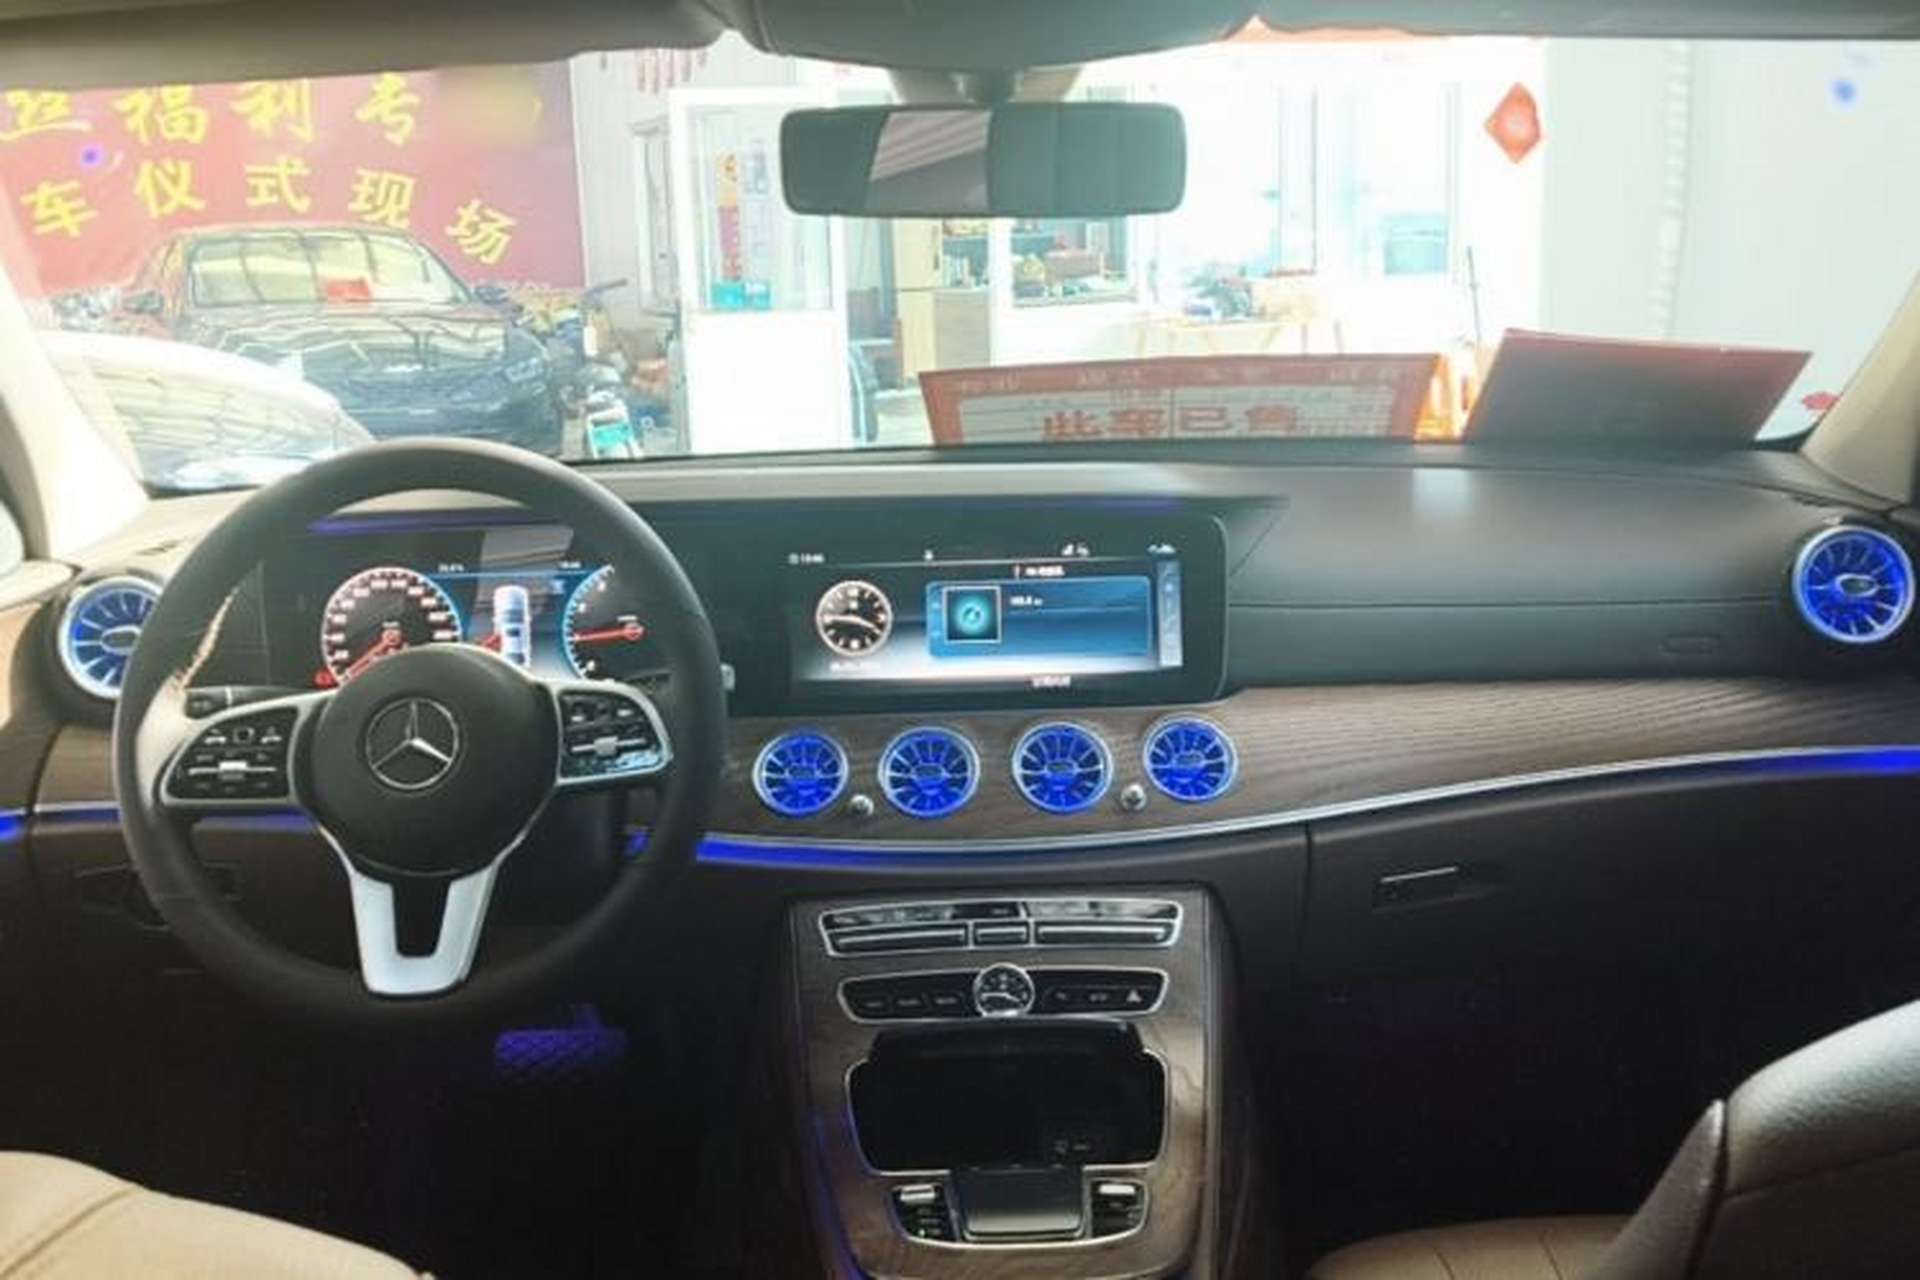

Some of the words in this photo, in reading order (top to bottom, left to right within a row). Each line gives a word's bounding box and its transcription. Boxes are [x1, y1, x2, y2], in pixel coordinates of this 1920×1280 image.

[20, 156, 517, 264] 车仪式现场
